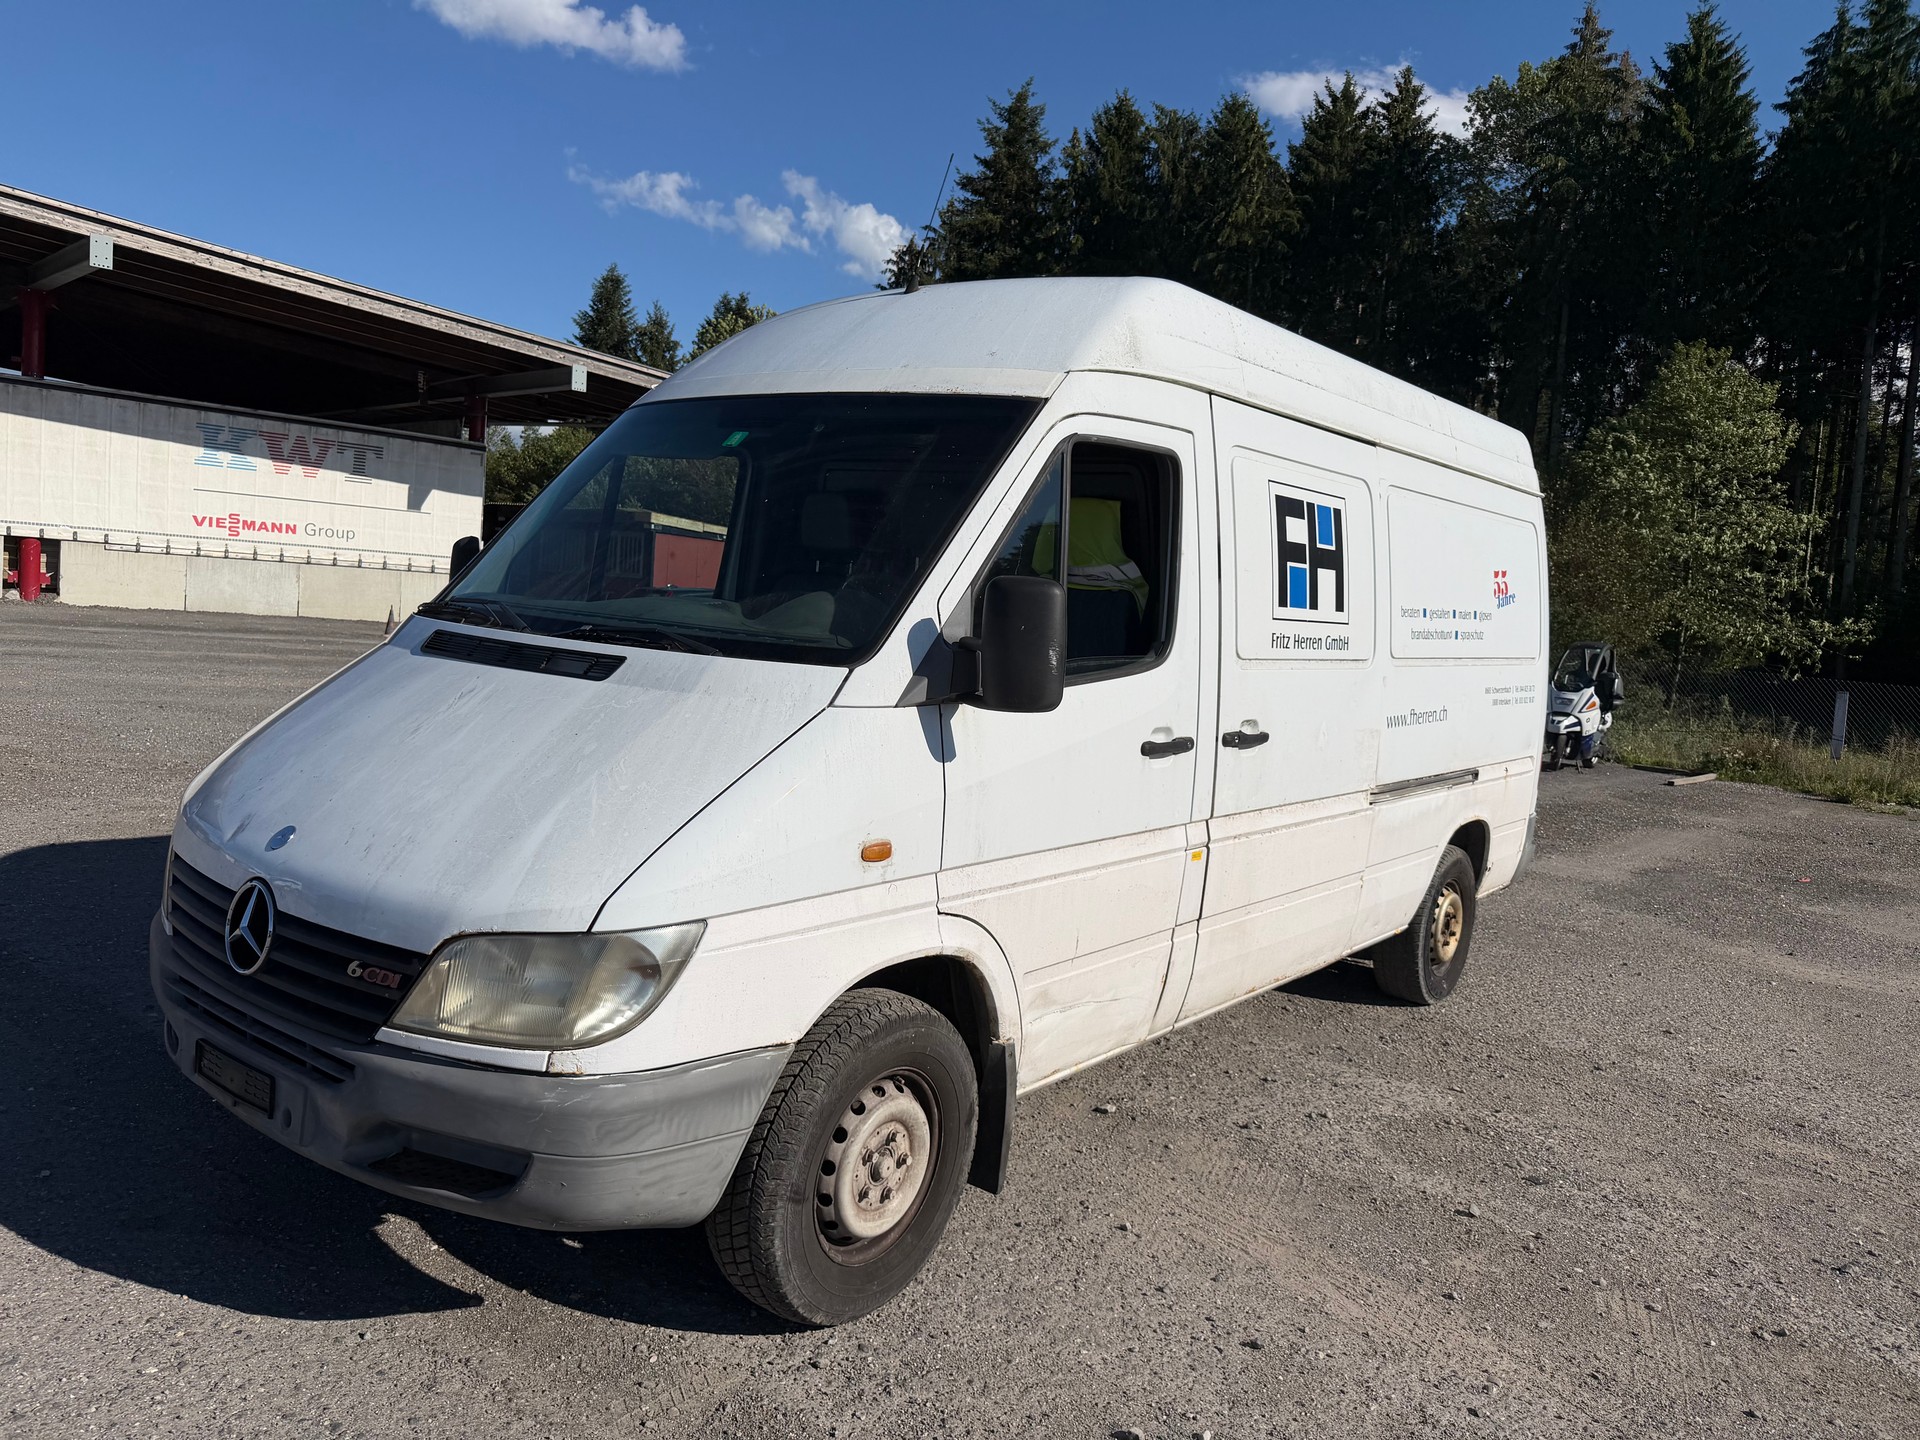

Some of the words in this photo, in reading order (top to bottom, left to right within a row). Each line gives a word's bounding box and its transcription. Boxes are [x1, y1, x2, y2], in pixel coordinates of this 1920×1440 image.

[194, 422, 384, 484] KWT
[192, 513, 297, 537] VIESSMANN
[305, 522, 356, 541] Group
[1493, 570, 1509, 599] 55
[1400, 605, 1420, 618] beraten
[1429, 608, 1450, 621] gestalten
[1458, 610, 1472, 620] malen
[1496, 593, 1516, 609] Jahre
[1271, 632, 1290, 649] Fritz
[1293, 634, 1322, 651] Herren
[1325, 635, 1349, 651] GmbH
[1386, 705, 1448, 729] www.fherren.ch
